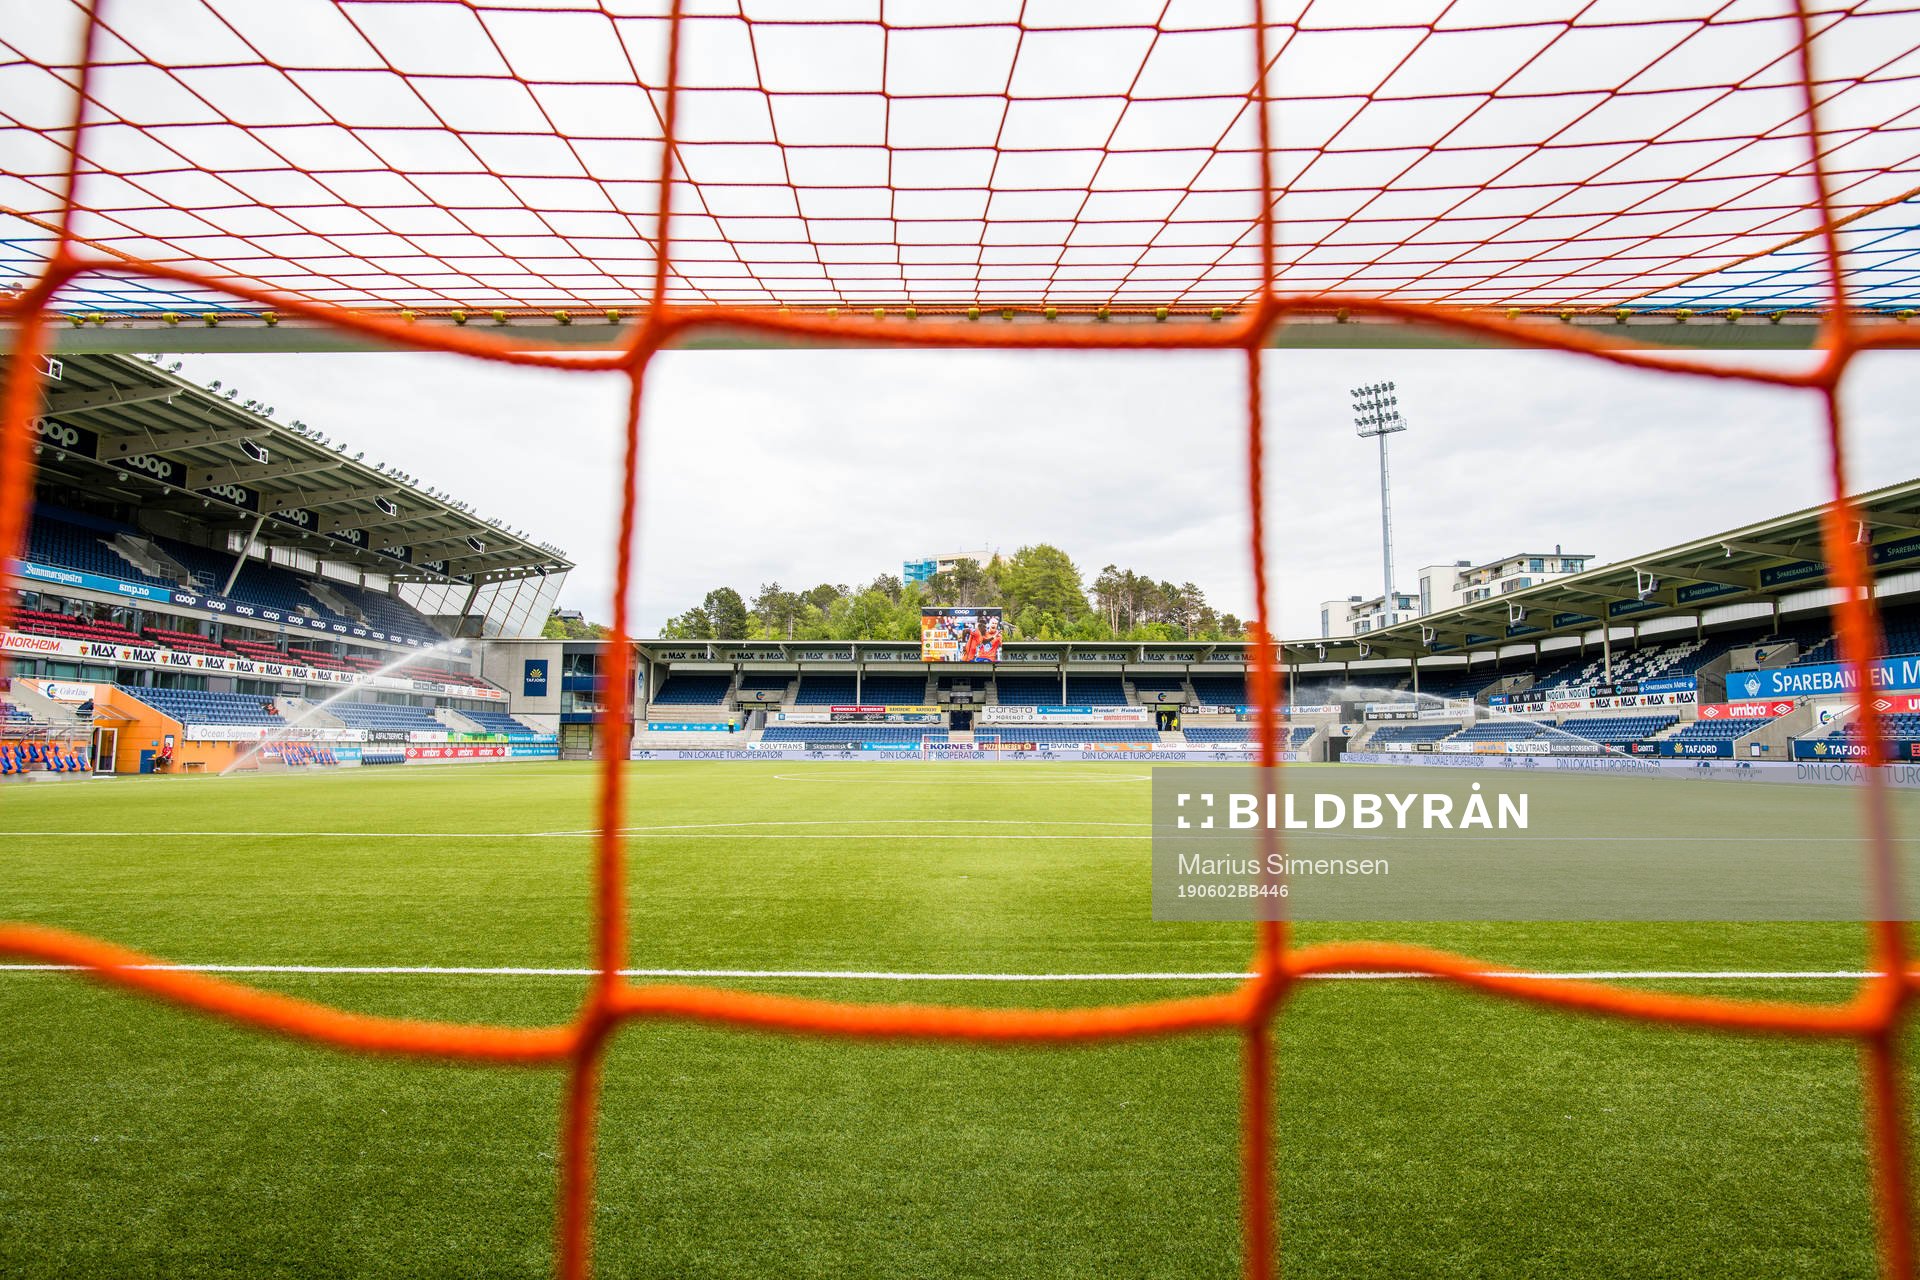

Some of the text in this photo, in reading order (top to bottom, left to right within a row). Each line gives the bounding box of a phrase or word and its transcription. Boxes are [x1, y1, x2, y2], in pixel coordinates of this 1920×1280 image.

[119, 583, 150, 596] smp.no
[175, 594, 196, 606] coop
[207, 600, 226, 611] coop
[236, 605, 254, 616] coop
[263, 610, 280, 621] coop
[288, 615, 304, 625] coop
[312, 620, 326, 629] coop
[333, 624, 347, 633] coop
[91, 644, 117, 658] MAX
[132, 649, 156, 662] MAX
[737, 652, 755, 660] MAX
[766, 652, 784, 660] MAX
[170, 653, 192, 666] MAX
[1010, 653, 1028, 661] MAX
[1040, 653, 1058, 661] MAX
[1079, 653, 1097, 661] MAX
[1108, 653, 1126, 661] MAX
[1147, 653, 1165, 661] MAX
[1177, 653, 1195, 661] MAX
[1212, 653, 1230, 661] MAX
[205, 657, 225, 670] MAX
[236, 661, 254, 673] MAX
[265, 664, 283, 676] MAX
[292, 667, 308, 679] MAX
[1773, 666, 1894, 693] SPAREBANEN
[1621, 697, 1636, 706] MAX
[1648, 694, 1665, 704] MAX
[1677, 692, 1695, 703] MAX
[1532, 703, 1544, 712] MAX
[1596, 698, 1610, 708] MAX
[1730, 705, 1766, 717] umbro
[200, 728, 225, 738] Ocean
[423, 749, 440, 757] umbro
[1685, 745, 1717, 754] TAFJORD
[679, 751, 783, 760] DIN LOKALE TUROPERATØR
[880, 751, 895, 760] DIN
[896, 751, 922, 760] LOKAL
[1082, 751, 1187, 760] DIN LOKALE TUROPERATØR
[1557, 759, 1568, 769] DIN
[1569, 759, 1597, 770] LOKALE
[1797, 764, 1821, 780] DIN
[1824, 765, 1869, 781] LOKAL
